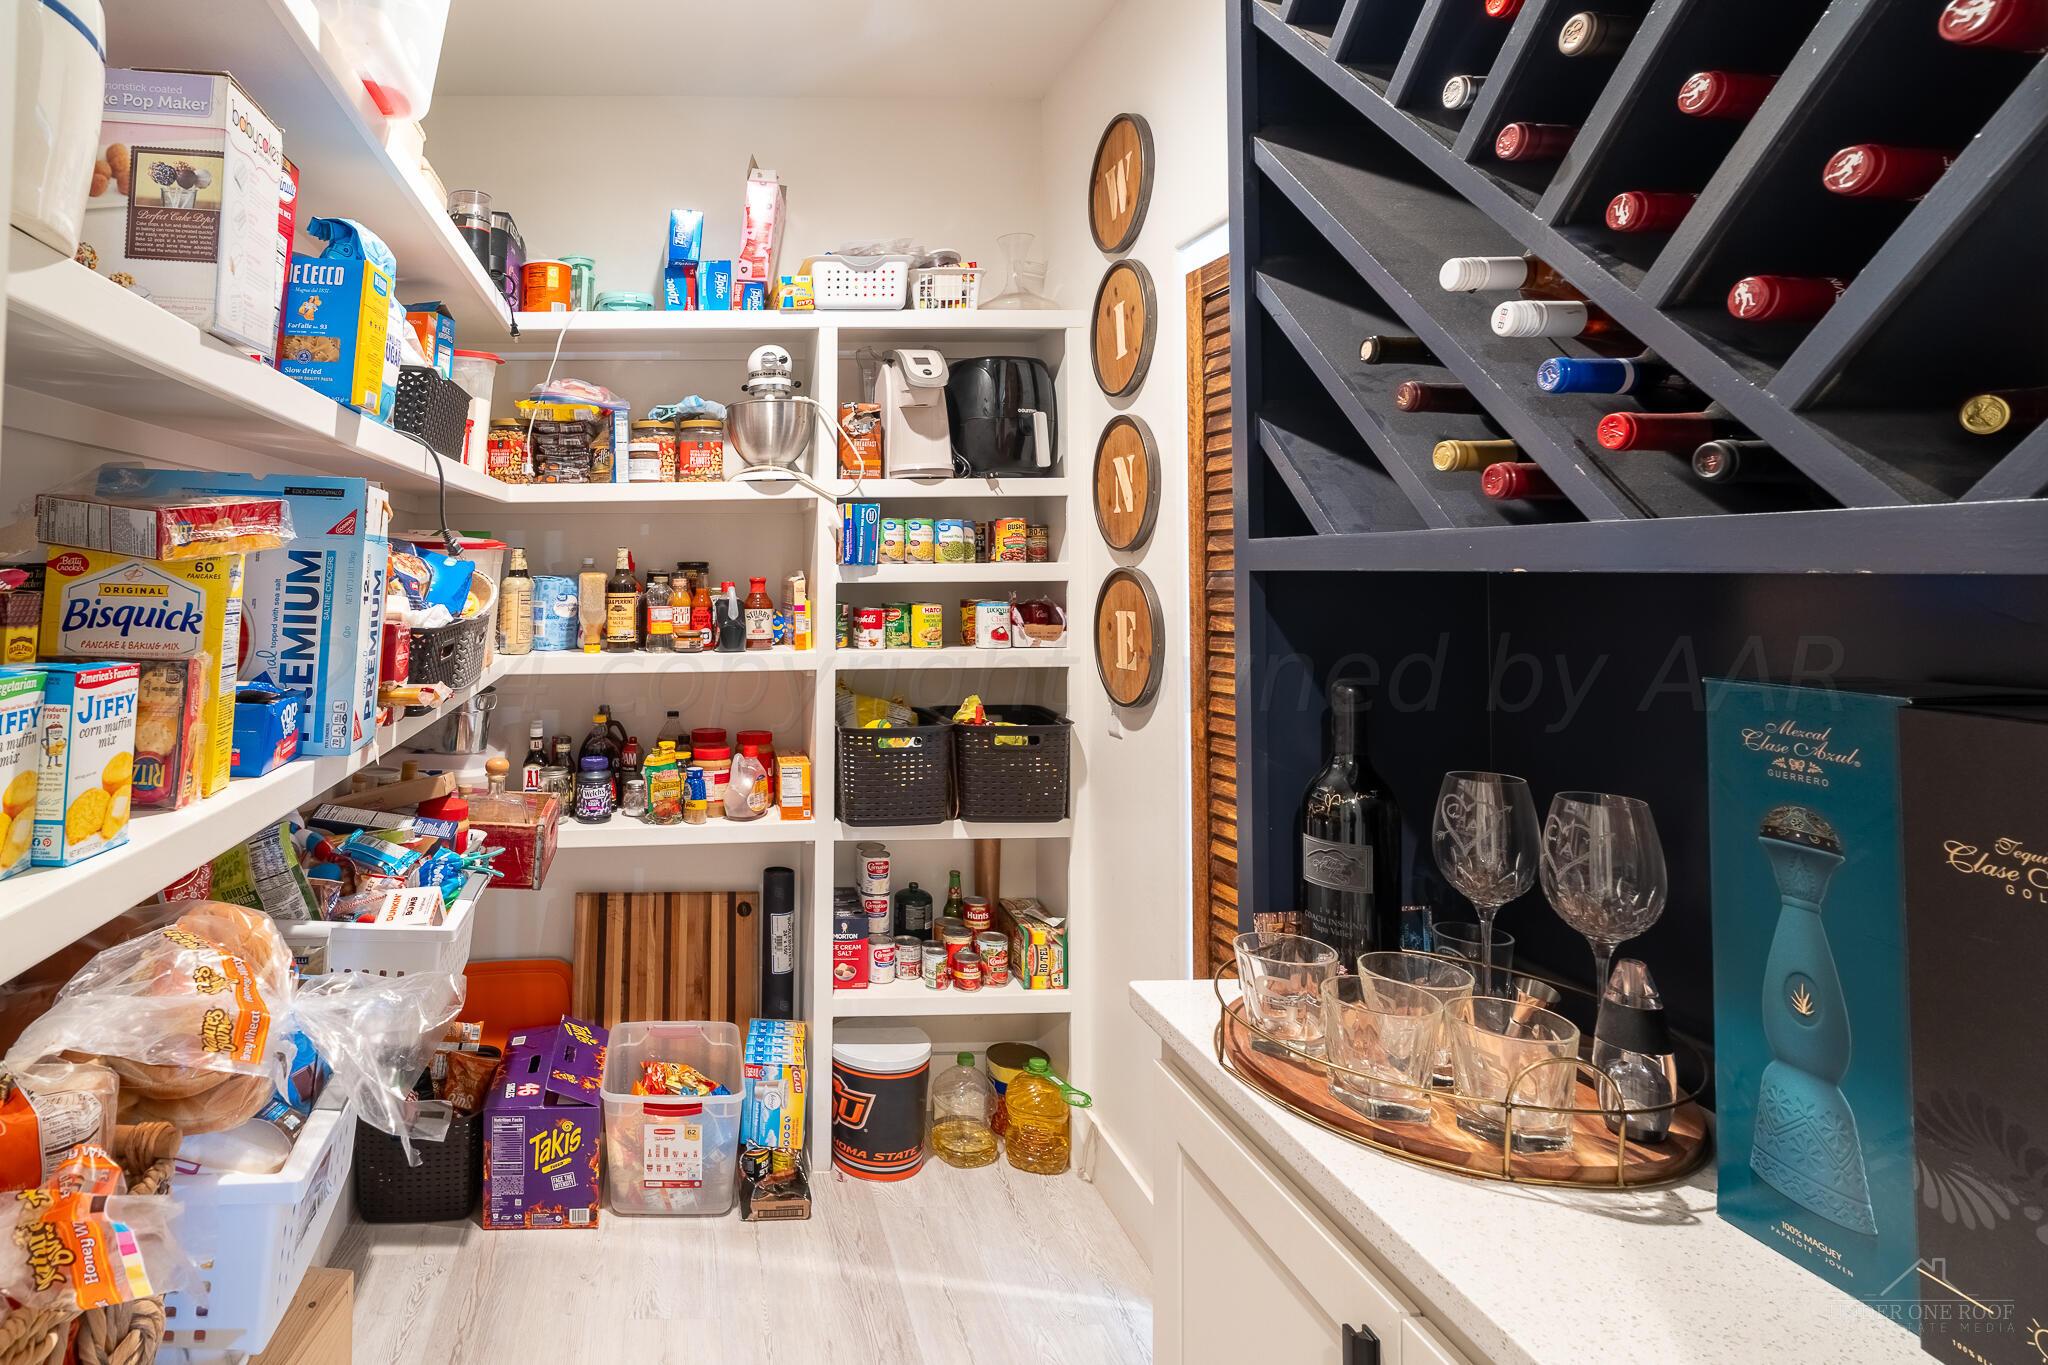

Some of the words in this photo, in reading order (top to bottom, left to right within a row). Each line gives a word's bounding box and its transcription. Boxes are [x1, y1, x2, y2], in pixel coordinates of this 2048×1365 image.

[150, 85, 182, 94] coated
[123, 94, 153, 109] Pop
[158, 96, 207, 111] Maker
[137, 210, 168, 224] Perfect
[170, 212, 191, 221] Cake
[303, 264, 344, 286] CECCO
[666, 278, 678, 305] Ziploc
[715, 272, 728, 299] Ziploc
[285, 366, 301, 374] Slow
[56, 562, 85, 572] Crocker
[62, 556, 82, 567] Betty
[194, 562, 214, 573] 60
[325, 556, 334, 592] CRACKERS
[104, 586, 164, 594] ORIGINAL
[273, 578, 281, 592] salt
[271, 607, 279, 622] with
[323, 594, 332, 620] SALTINE
[62, 598, 203, 637] Bisquick
[81, 640, 120, 649] PANCAKE
[128, 641, 161, 650] BAKING
[162, 642, 180, 650] MIX
[271, 623, 280, 649] topped
[279, 550, 323, 741] EMIUM
[363, 569, 382, 720] PREMIUM
[78, 672, 113, 684] America's
[113, 667, 138, 678] Favorite
[77, 694, 136, 724] JIFFY
[0, 706, 42, 736] IFFY
[79, 724, 102, 739] corn
[105, 716, 132, 734] muffin
[1765, 720, 1831, 741] Mezcal
[7, 732, 37, 750] muffin
[99, 734, 117, 748] mix
[1741, 728, 1790, 755] Clase
[1793, 741, 1857, 767] Azul
[0, 752, 20, 768] mix
[1767, 768, 1829, 787] GUERRERO
[1943, 840, 2021, 882] Clase
[221, 884, 250, 900] DOUBLE
[2005, 885, 2048, 904] GOL
[1304, 908, 1327, 924] COACH
[1312, 922, 1328, 934] Napa
[1330, 926, 1353, 938] Valley
[792, 1070, 801, 1093] GLAD
[529, 1120, 582, 1170] Takis
[873, 1145, 918, 1161] STATE
[552, 1175, 563, 1183] FACE
[564, 1173, 573, 1181] THE
[553, 1180, 575, 1189] INTENSITY
[1781, 1221, 1803, 1240] 100%
[1803, 1232, 1843, 1261] MAGUEY
[1771, 1225, 1813, 1255] PAPALOTE
[1825, 1257, 1854, 1278] JOVEN
[83, 1238, 99, 1285] Honey
[1952, 1339, 1975, 1358] 100%
